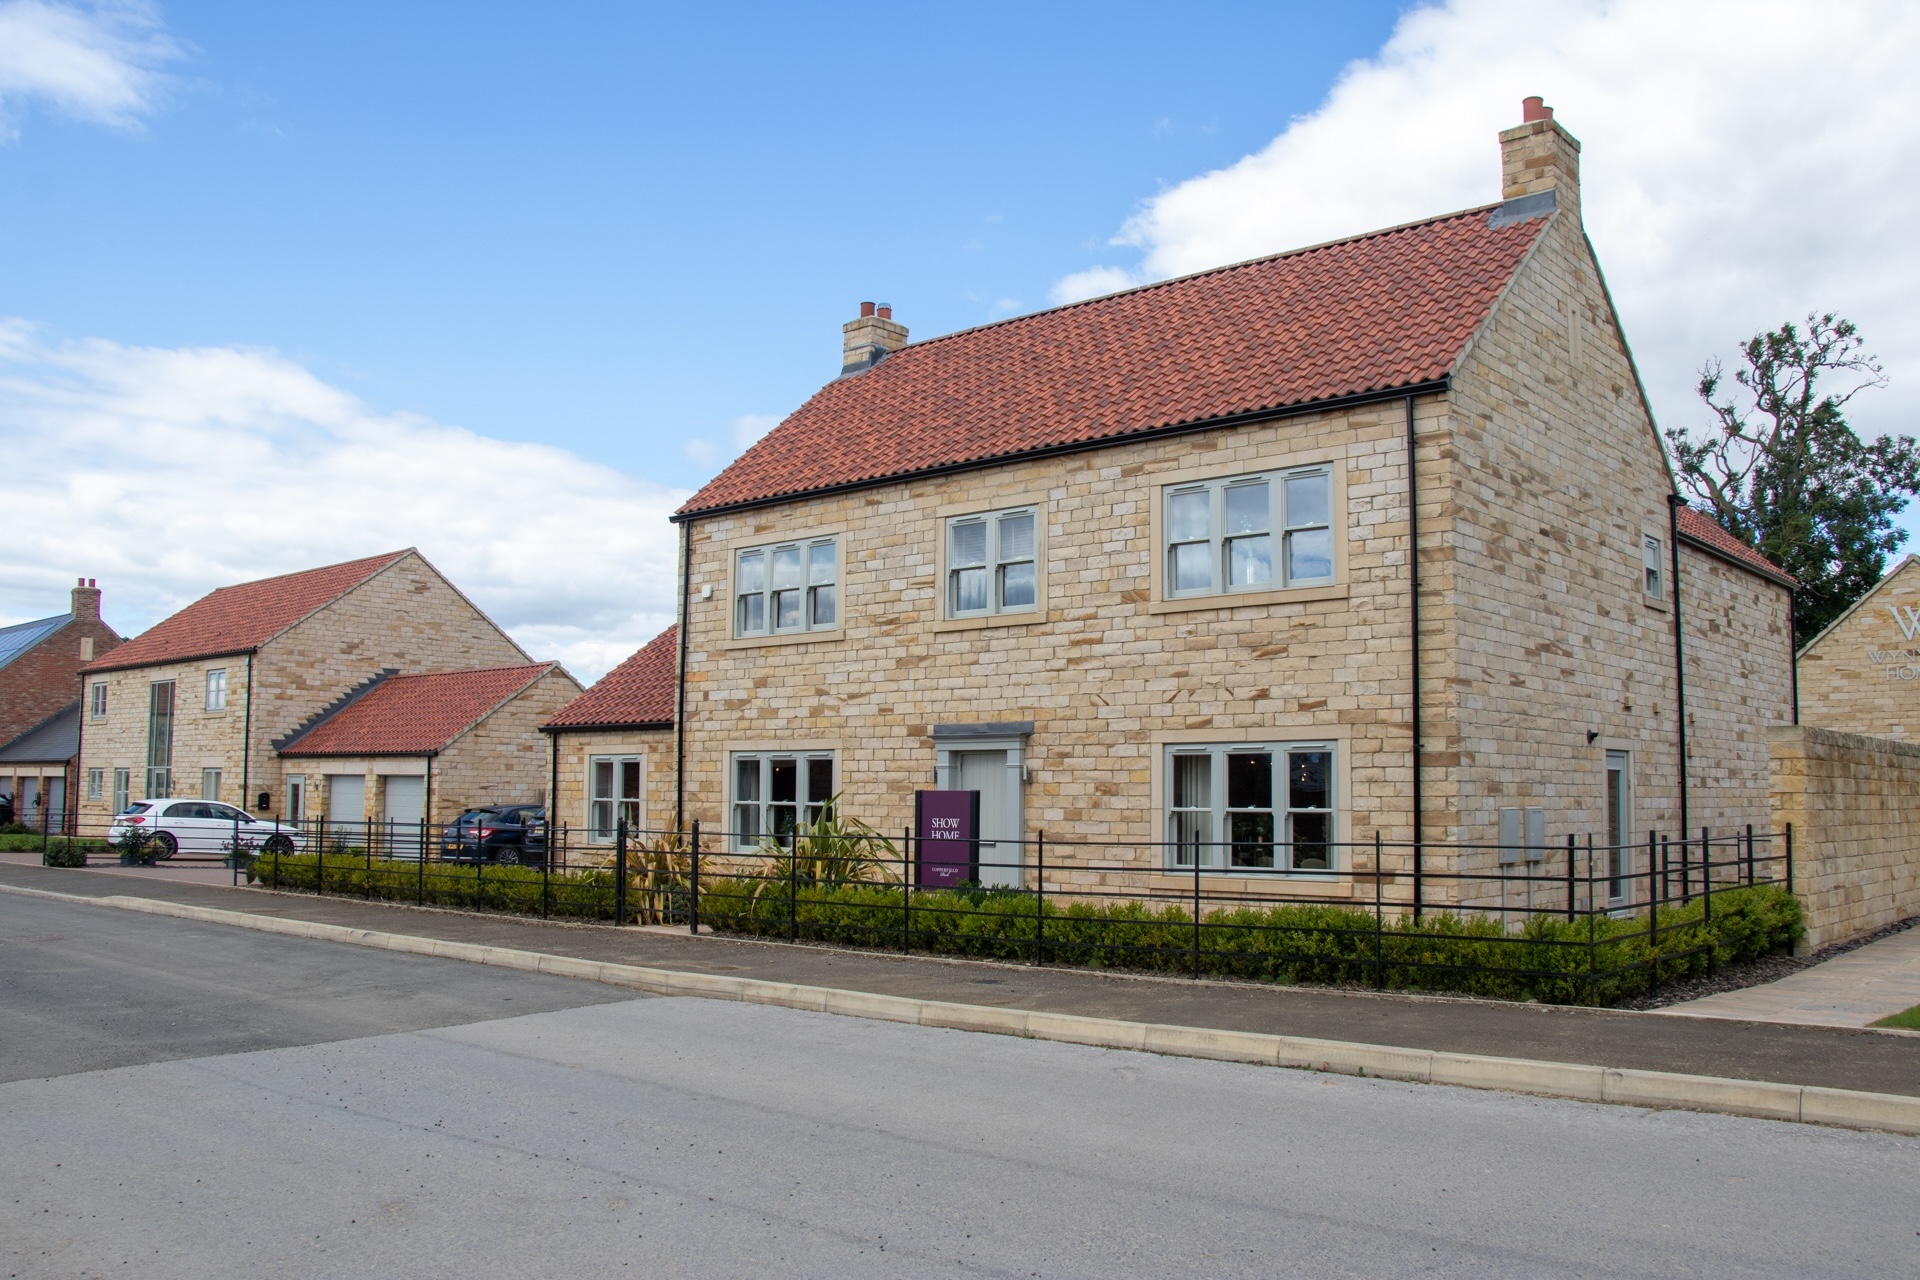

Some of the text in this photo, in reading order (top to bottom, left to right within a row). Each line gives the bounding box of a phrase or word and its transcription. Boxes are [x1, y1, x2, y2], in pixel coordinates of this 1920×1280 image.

[1868, 650, 1920, 664] WYN
[932, 818, 959, 828] SHOW
[932, 830, 959, 839] HOME
